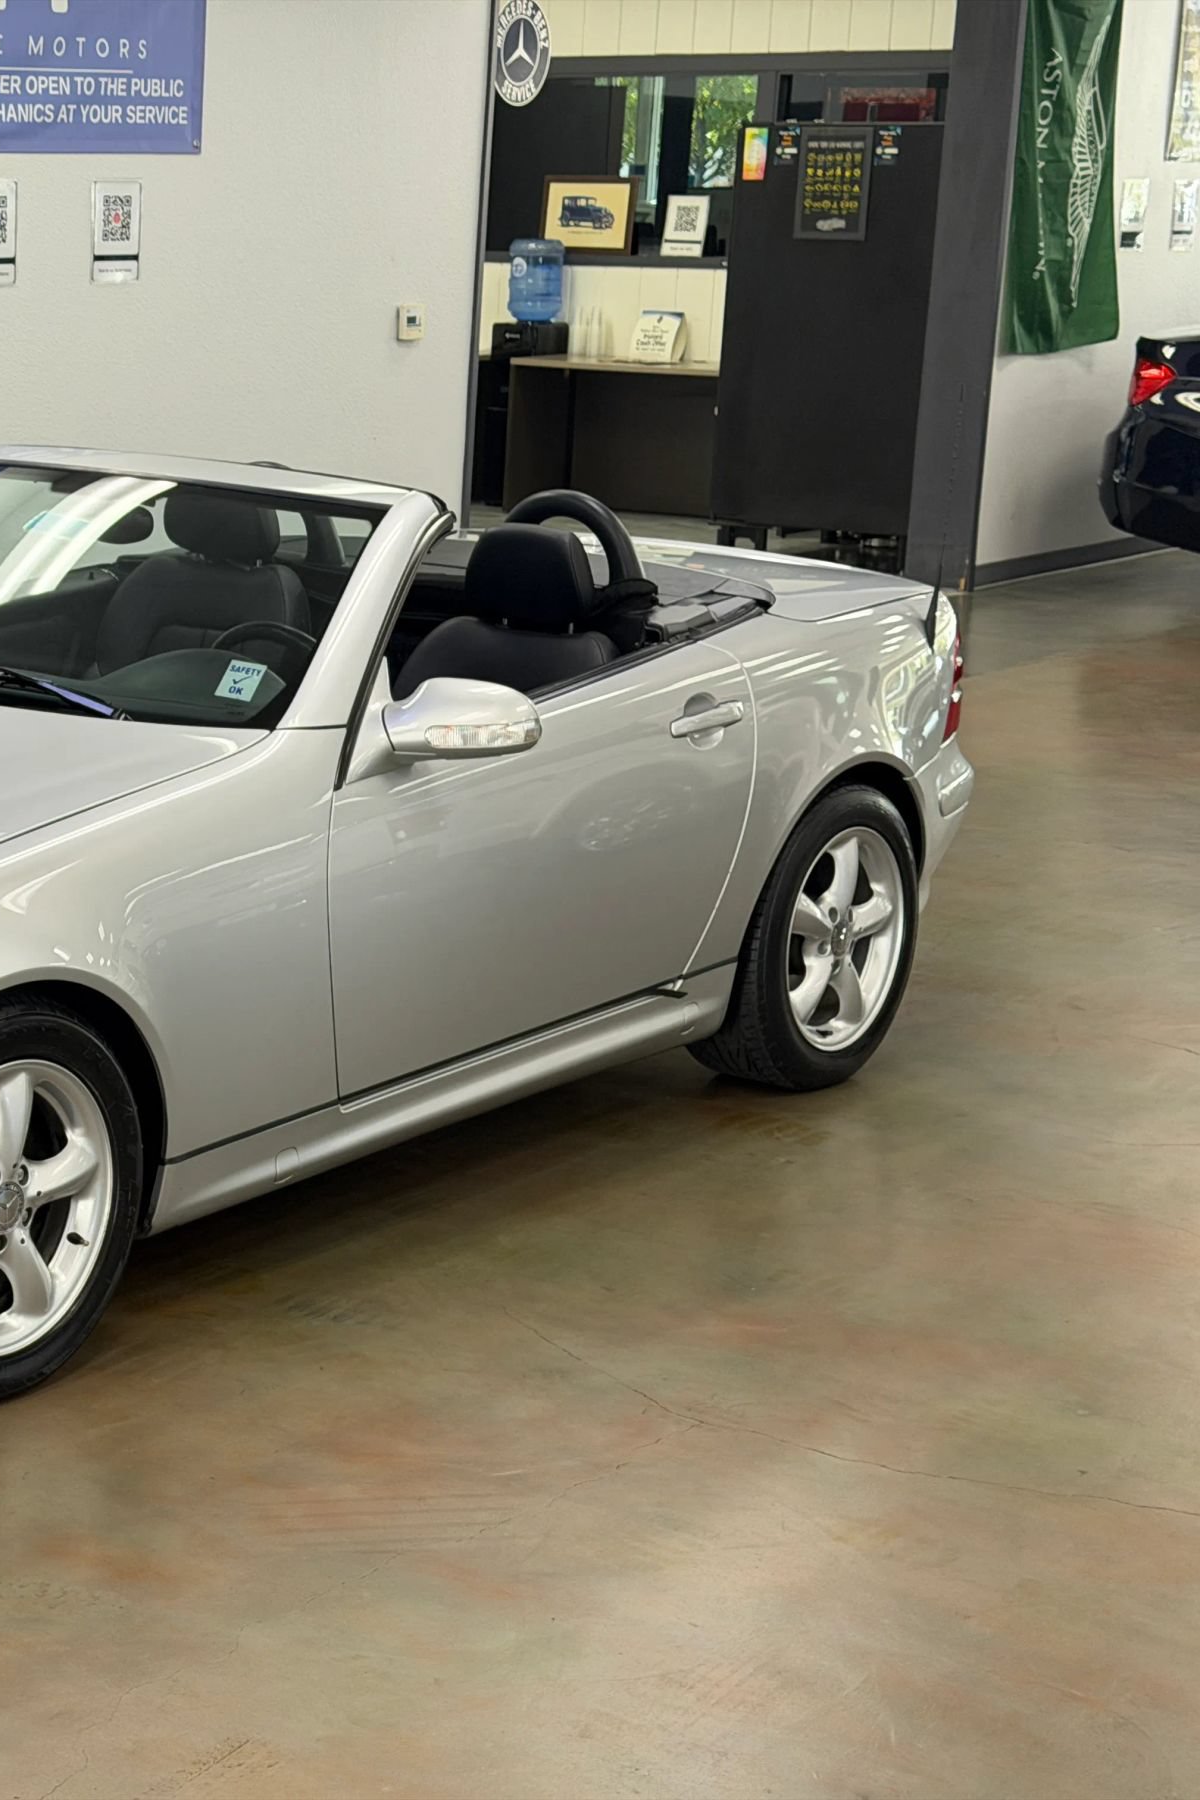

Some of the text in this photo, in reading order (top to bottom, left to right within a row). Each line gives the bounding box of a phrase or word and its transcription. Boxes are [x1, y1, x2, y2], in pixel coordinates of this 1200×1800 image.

[28, 35, 147, 60] MOTORS
[25, 75, 70, 96] OPEN
[74, 76, 95, 96] TO
[99, 77, 127, 97] THE
[130, 78, 184, 97] PUBLIC
[502, 78, 537, 102] SERVICE
[1035, 47, 1063, 149] ASTON
[57, 104, 76, 124] AT
[80, 104, 122, 124] YOUR
[126, 105, 188, 125] SERVICE
[229, 664, 262, 677] SAFETY
[228, 685, 244, 696] OK
